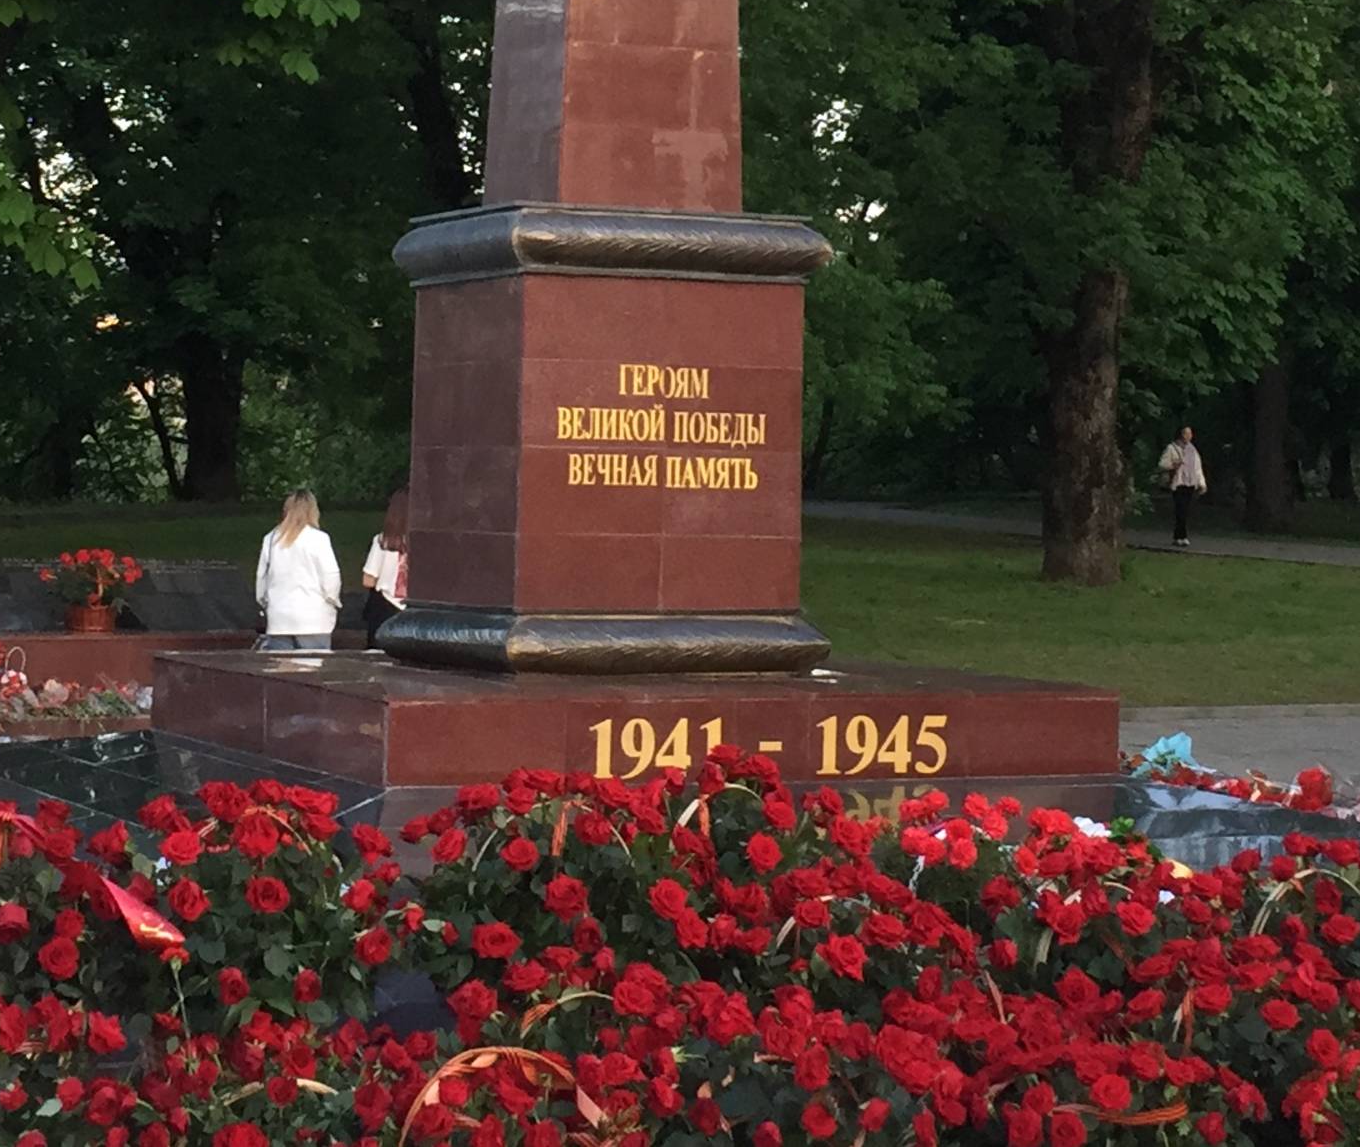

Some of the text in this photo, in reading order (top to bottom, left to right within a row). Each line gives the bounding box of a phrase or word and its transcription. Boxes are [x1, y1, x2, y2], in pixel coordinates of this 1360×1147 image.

[618, 364, 709, 399] ГЕРОЯМ
[557, 404, 767, 450] ВЕЛИКОЙ ПОБЕДЫ
[568, 453, 758, 490] ВЕЧНАЯ ПАМЯТЬ
[816, 715, 948, 775] 1945
